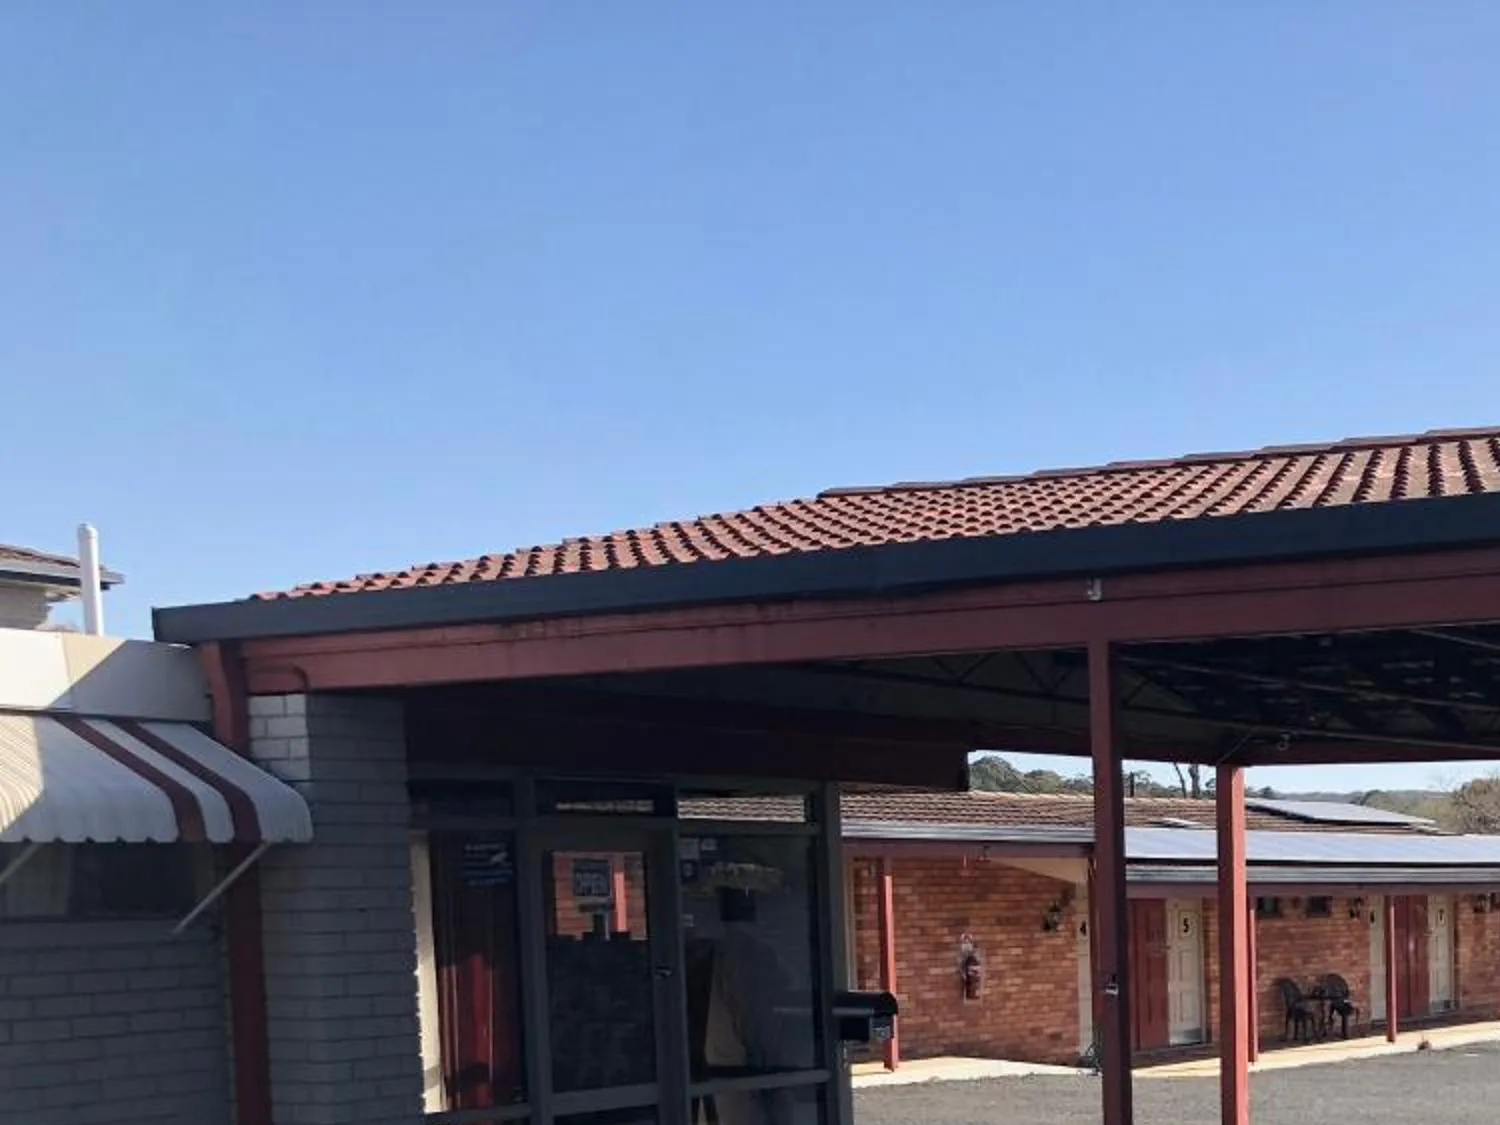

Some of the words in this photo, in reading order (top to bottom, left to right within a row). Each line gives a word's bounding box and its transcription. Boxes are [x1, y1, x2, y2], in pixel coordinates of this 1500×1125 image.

[574, 871, 609, 897] OPEN
[1079, 919, 1088, 936] 4
[1183, 917, 1190, 933] 5
